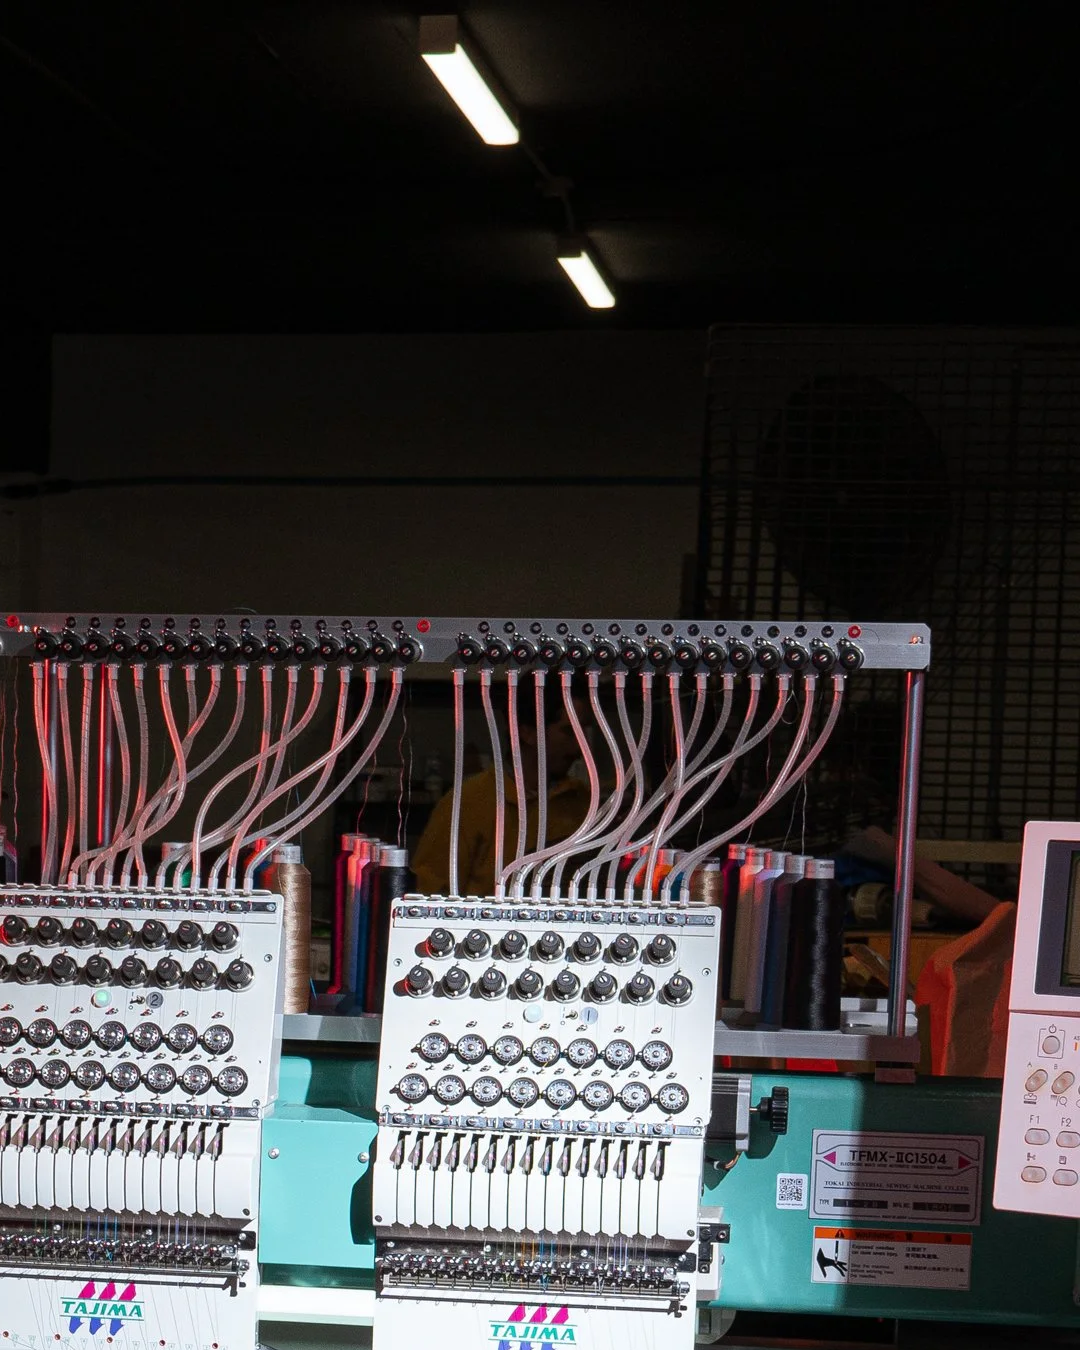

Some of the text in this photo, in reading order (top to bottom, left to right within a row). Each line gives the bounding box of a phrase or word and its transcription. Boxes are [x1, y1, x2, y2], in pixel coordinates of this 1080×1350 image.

[150, 994, 159, 1006] 2
[1029, 1114, 1040, 1124] F1
[1061, 1117, 1072, 1128] F2
[61, 1301, 143, 1318] TAJIMA
[490, 1324, 576, 1341] TAJIMA
